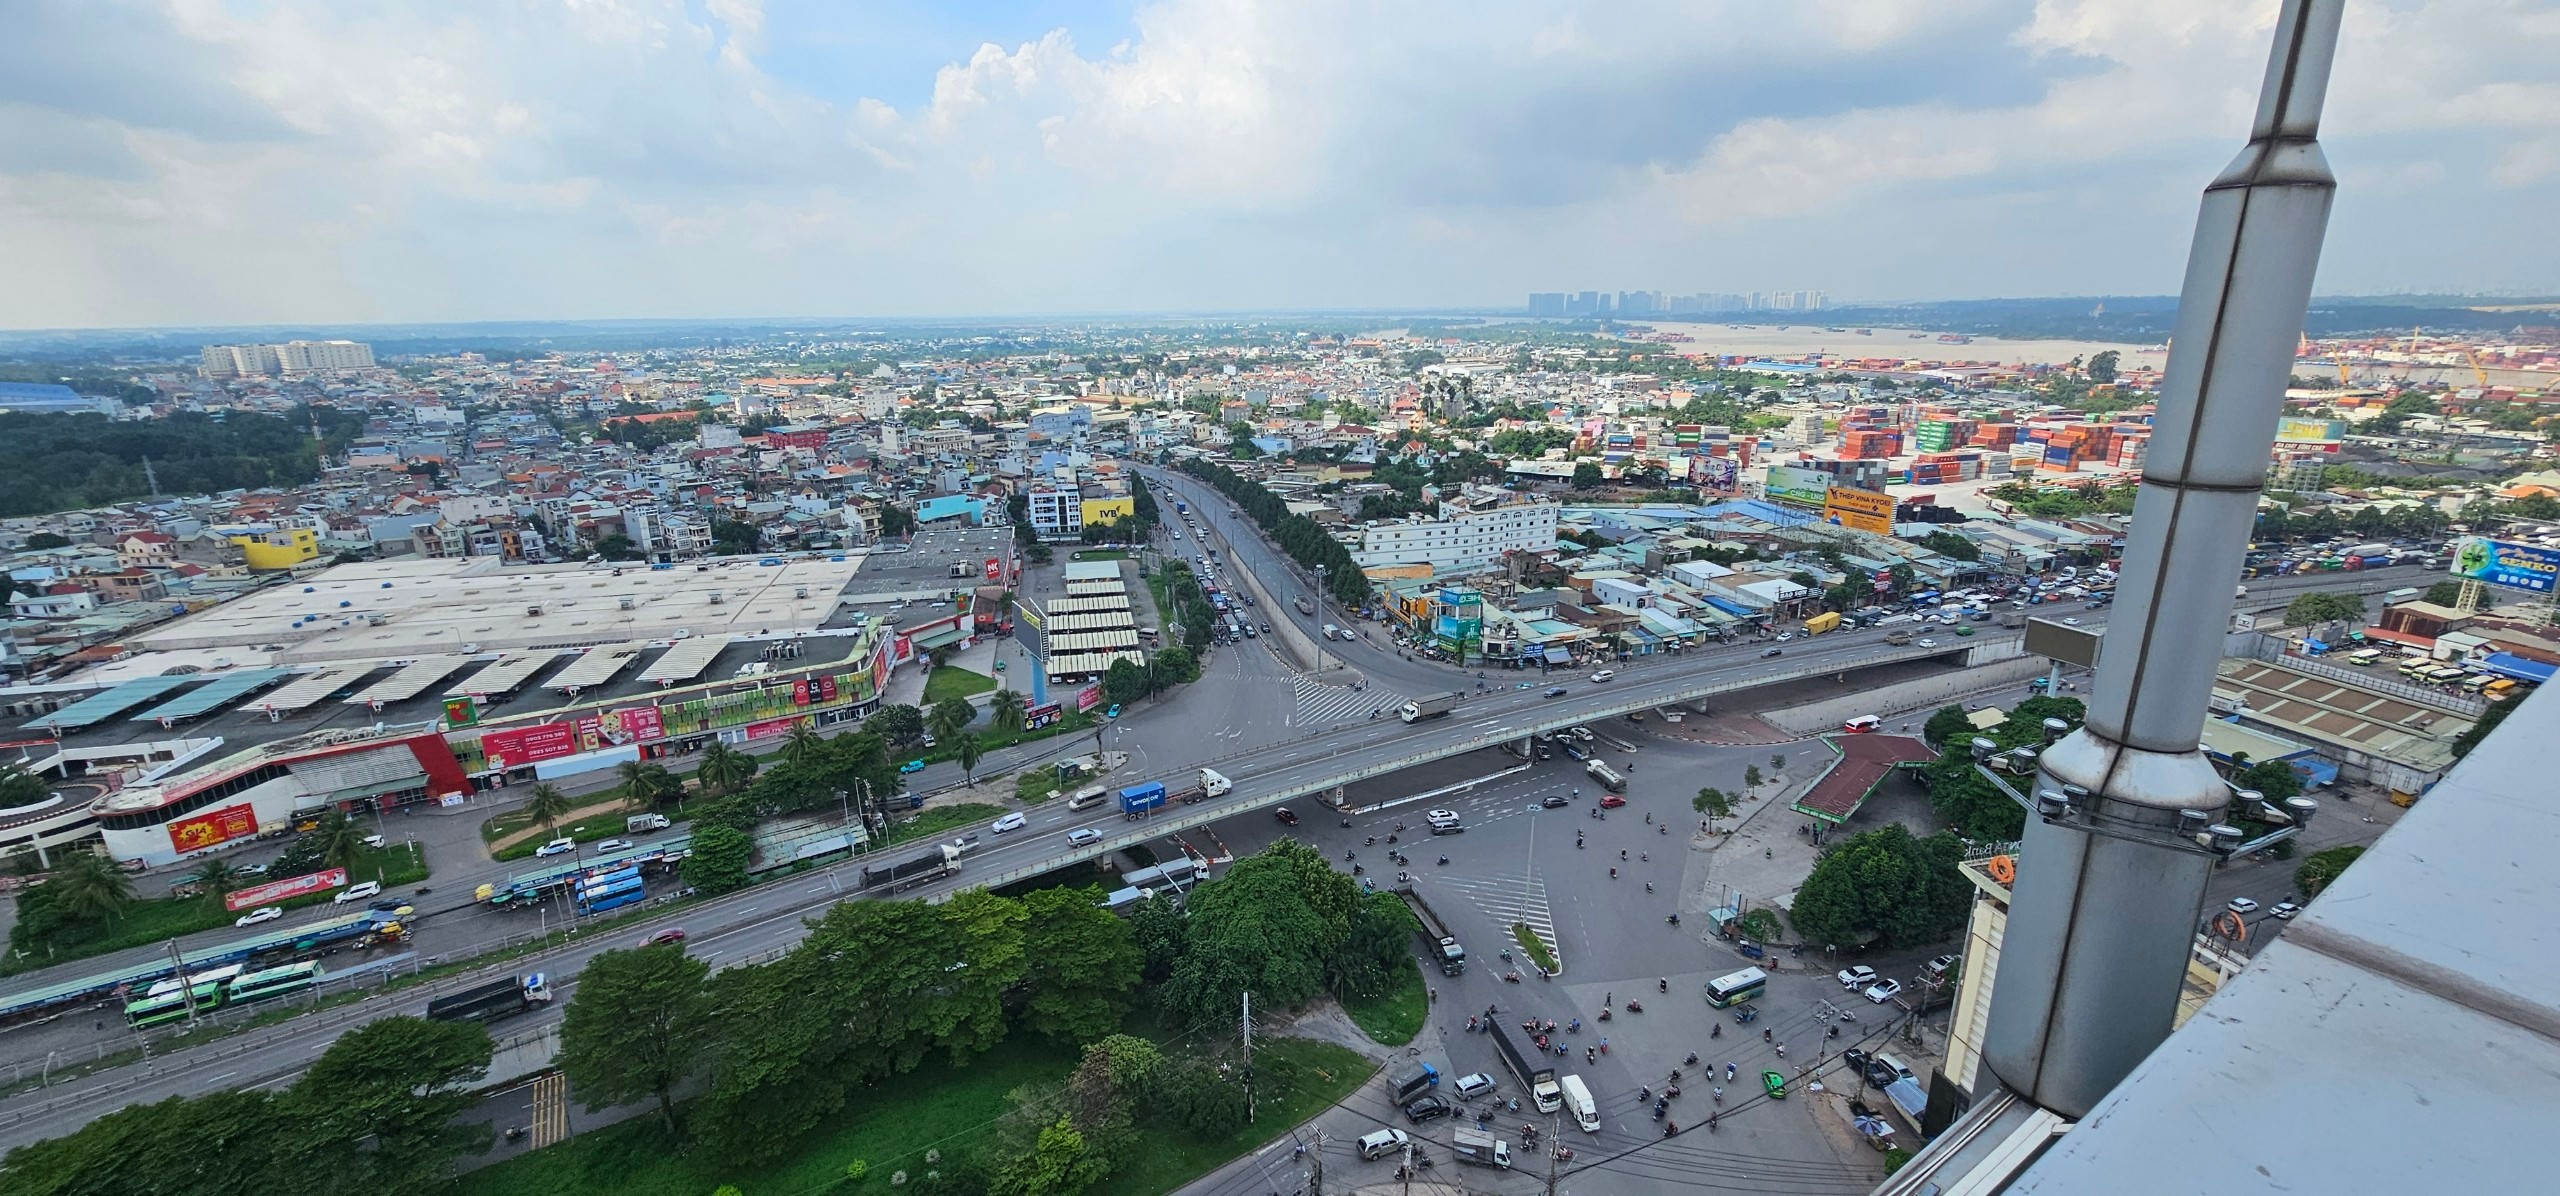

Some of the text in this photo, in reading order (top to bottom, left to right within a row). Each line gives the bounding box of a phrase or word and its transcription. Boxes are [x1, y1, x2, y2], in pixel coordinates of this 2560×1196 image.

[1790, 490, 1806, 498] CNG
[987, 562, 998, 572] NK
[2499, 556, 2557, 572] SENKO
[185, 824, 207, 837] GIÁ
